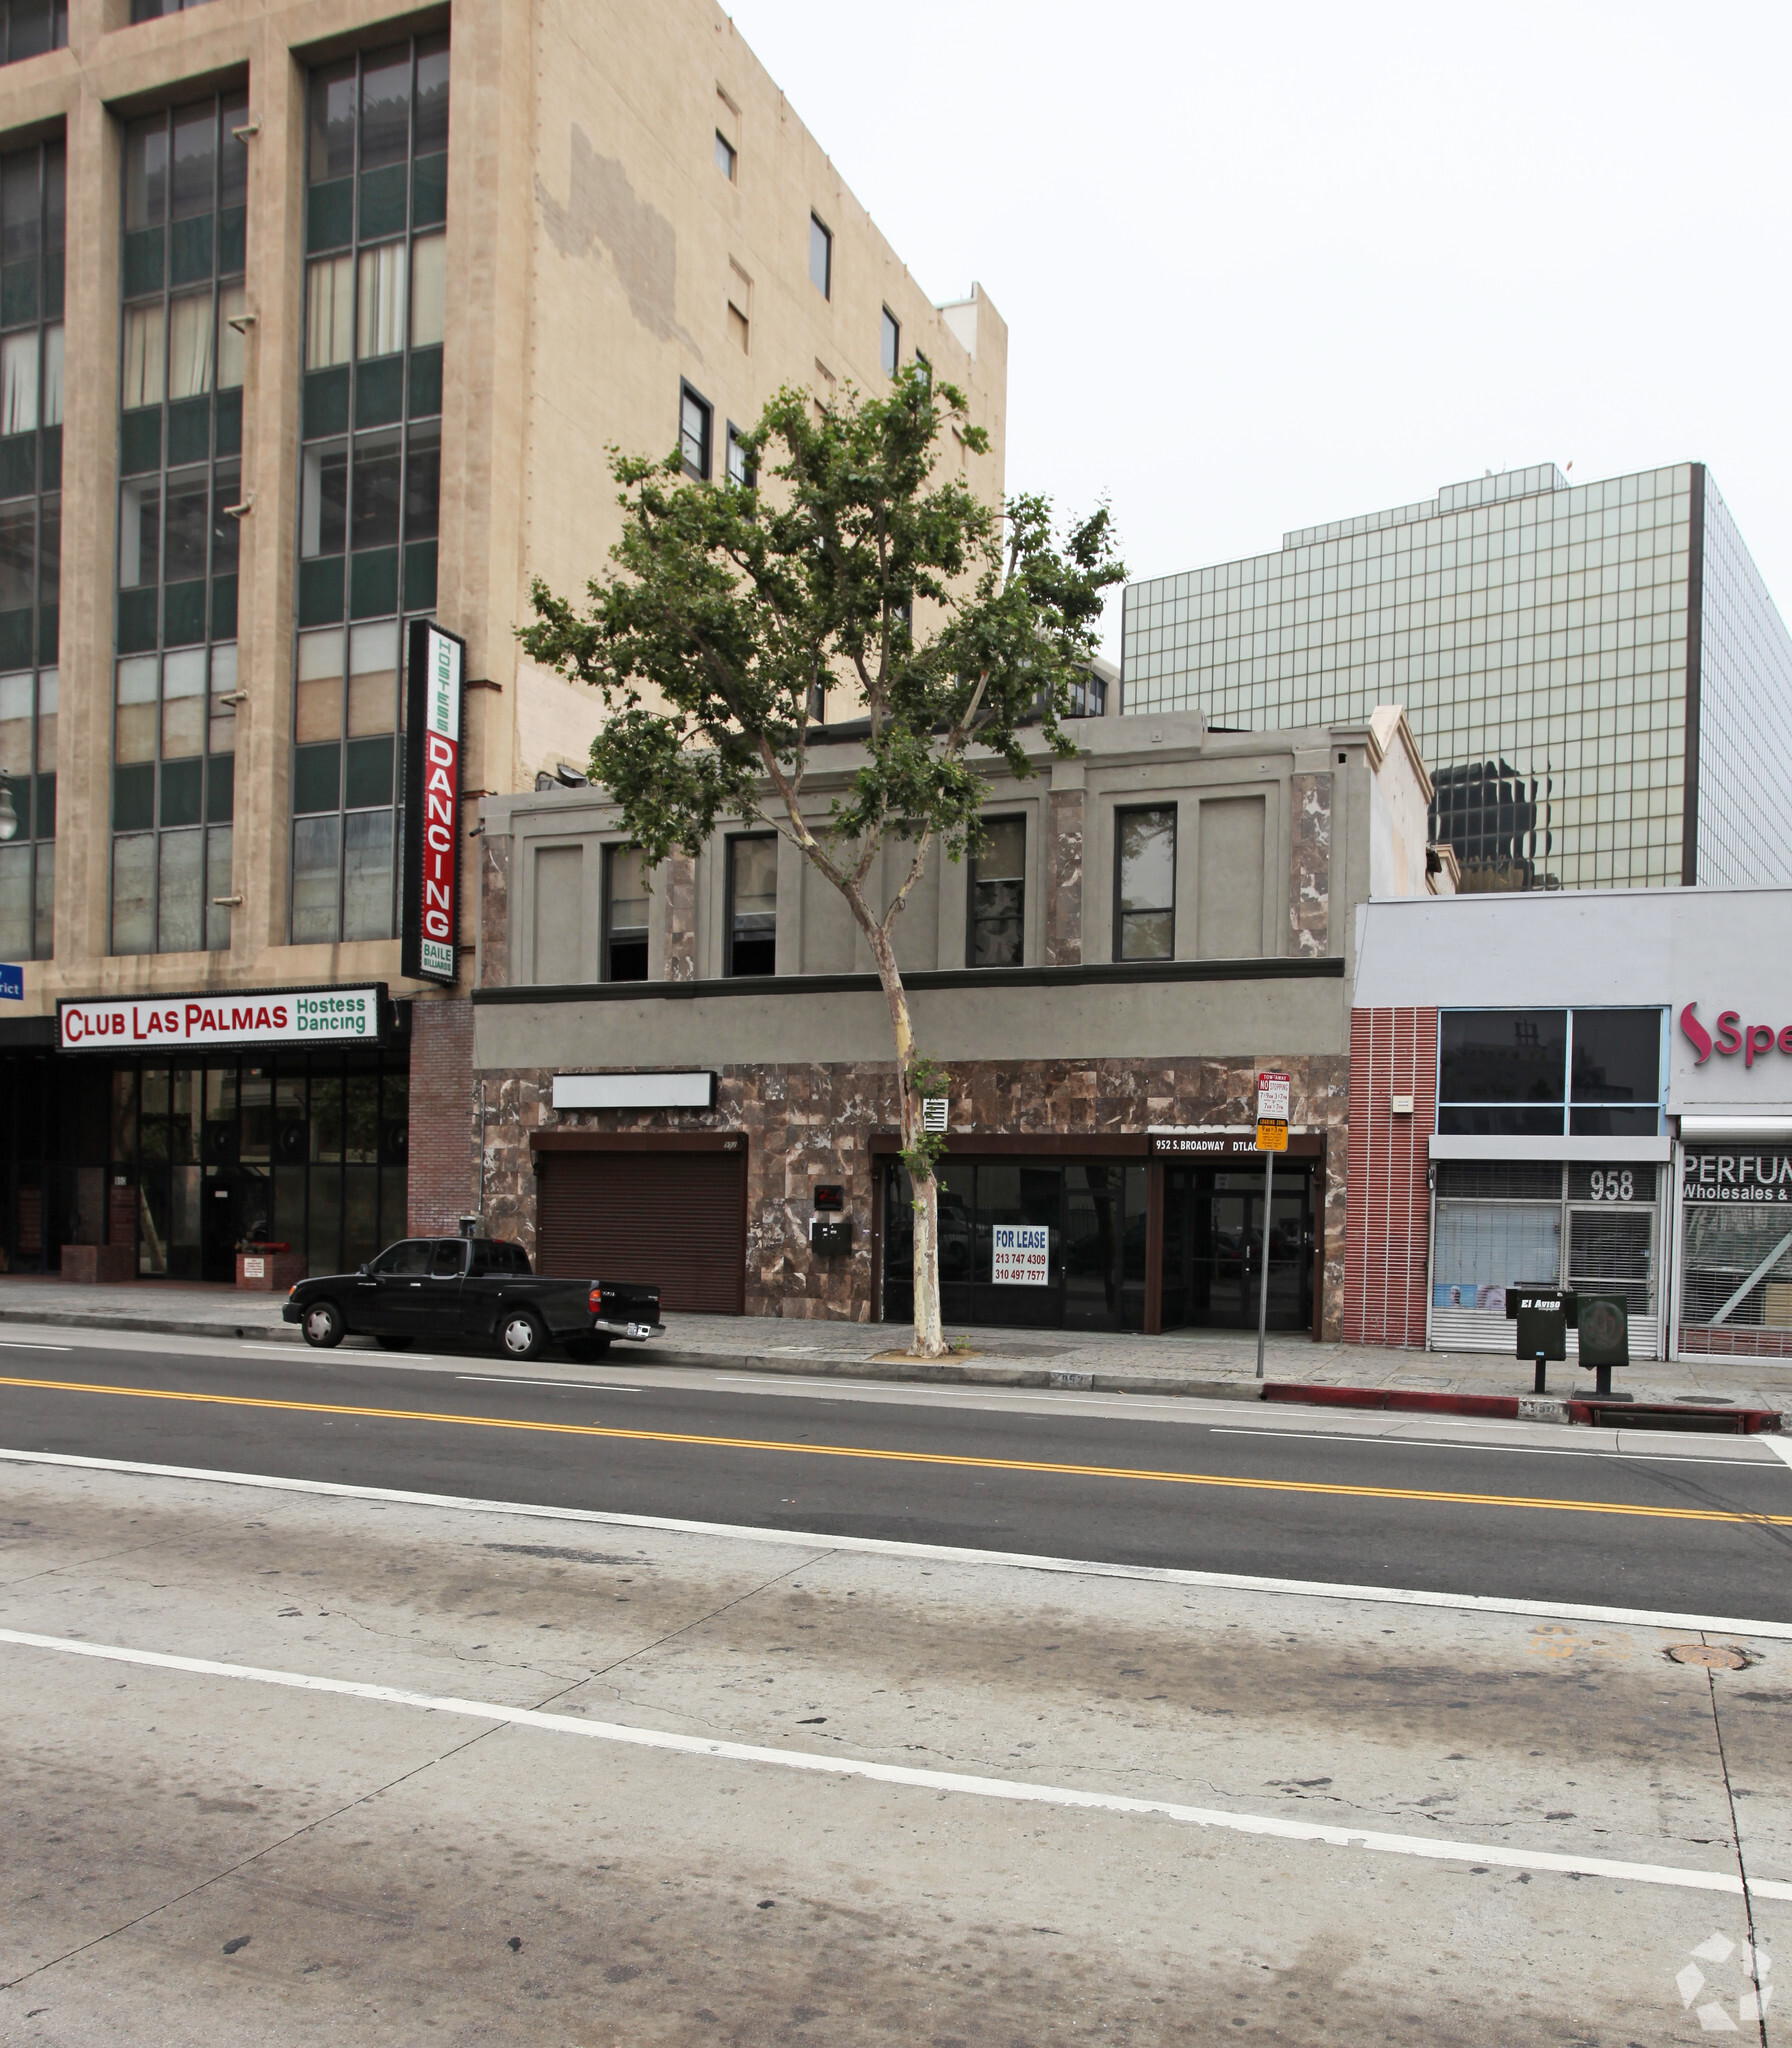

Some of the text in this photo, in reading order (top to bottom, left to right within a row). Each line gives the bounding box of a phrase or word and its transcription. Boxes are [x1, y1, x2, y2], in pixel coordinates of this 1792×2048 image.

[437, 639, 451, 732] HOSTESS
[426, 736, 452, 938] DANCING
[424, 944, 452, 962] BAILE
[424, 958, 452, 971] BILLIARDS
[296, 998, 366, 1014] Hostess
[65, 1004, 288, 1042] CLUB LAS PALMAS
[297, 1016, 366, 1034] Dancing
[1260, 1080, 1288, 1091] NO STOPPING
[1156, 1140, 1170, 1150] 952
[1180, 1140, 1224, 1150] BROADWAY
[1590, 1170, 1634, 1200] 958
[1684, 1184, 1788, 1200] Wholesales &
[996, 1230, 1046, 1248] FOR LEASE
[996, 1254, 1046, 1265] 213 747 4309
[995, 1269, 1046, 1280] 310 497 7577
